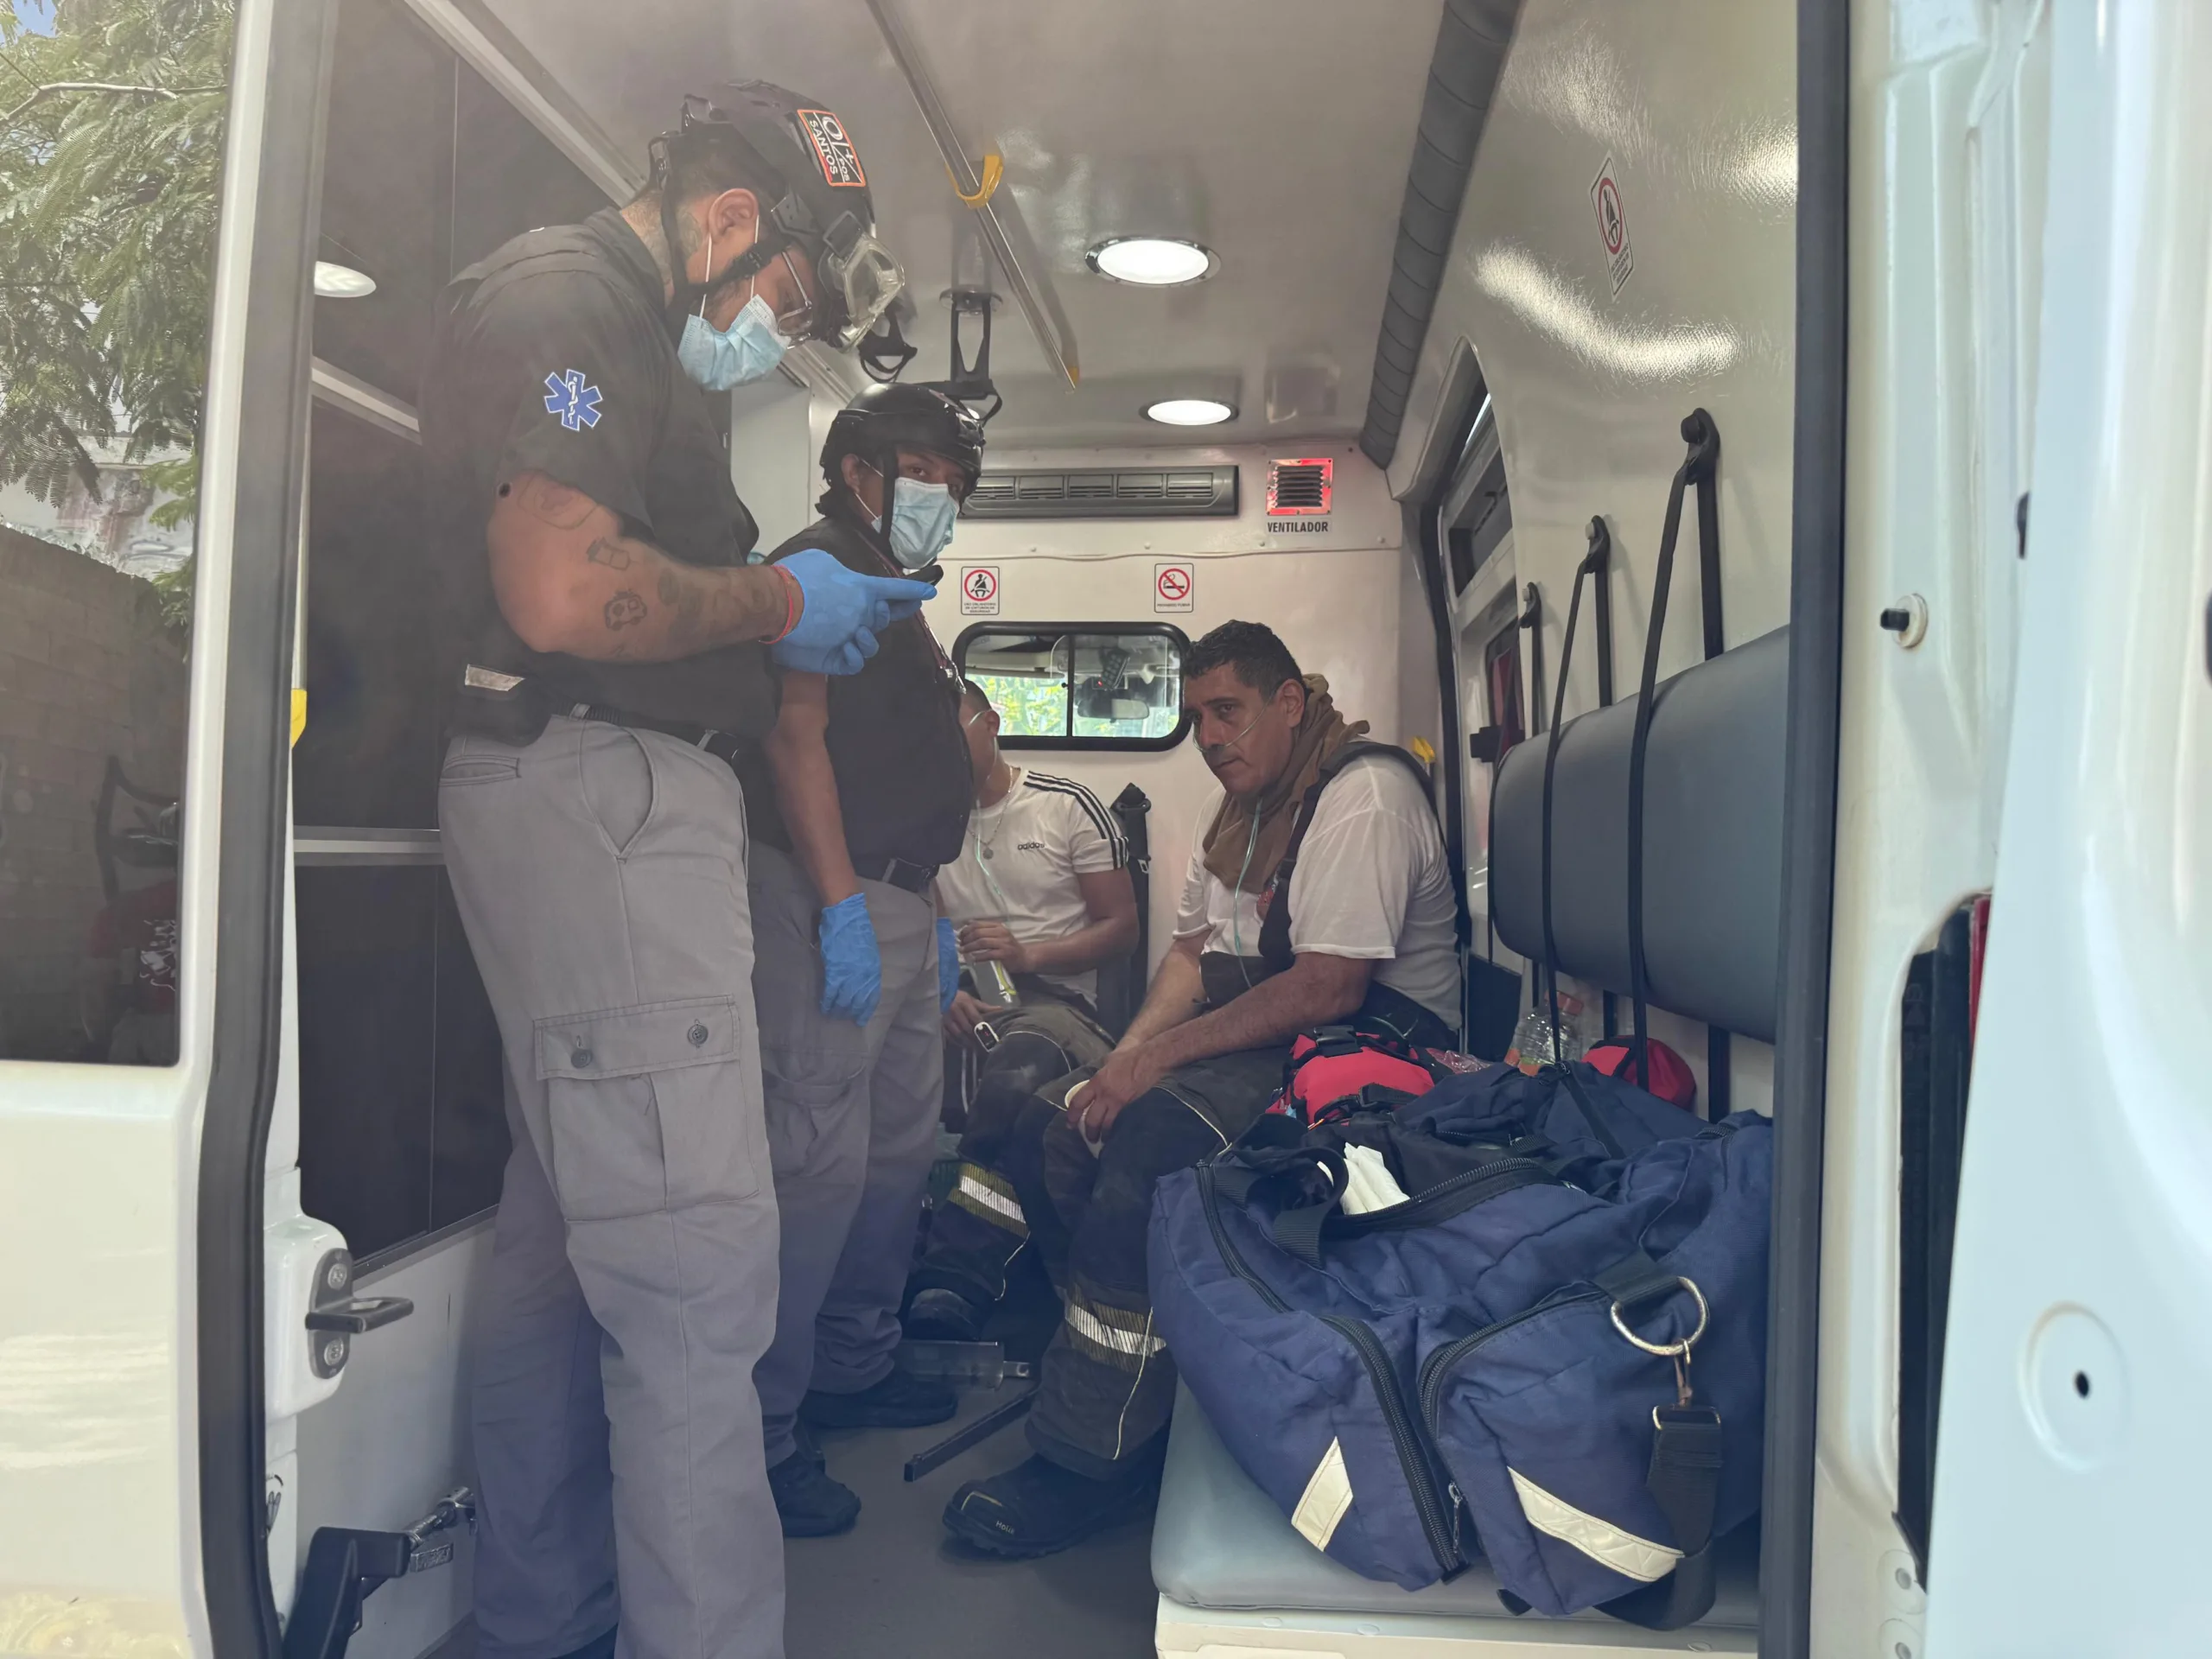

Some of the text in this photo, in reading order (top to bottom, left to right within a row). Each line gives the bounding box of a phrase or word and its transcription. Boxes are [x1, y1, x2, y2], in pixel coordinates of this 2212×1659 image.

[810, 119, 839, 175] SANTOS
[839, 158, 850, 181] POS
[1267, 521, 1329, 533] VENTILADOR
